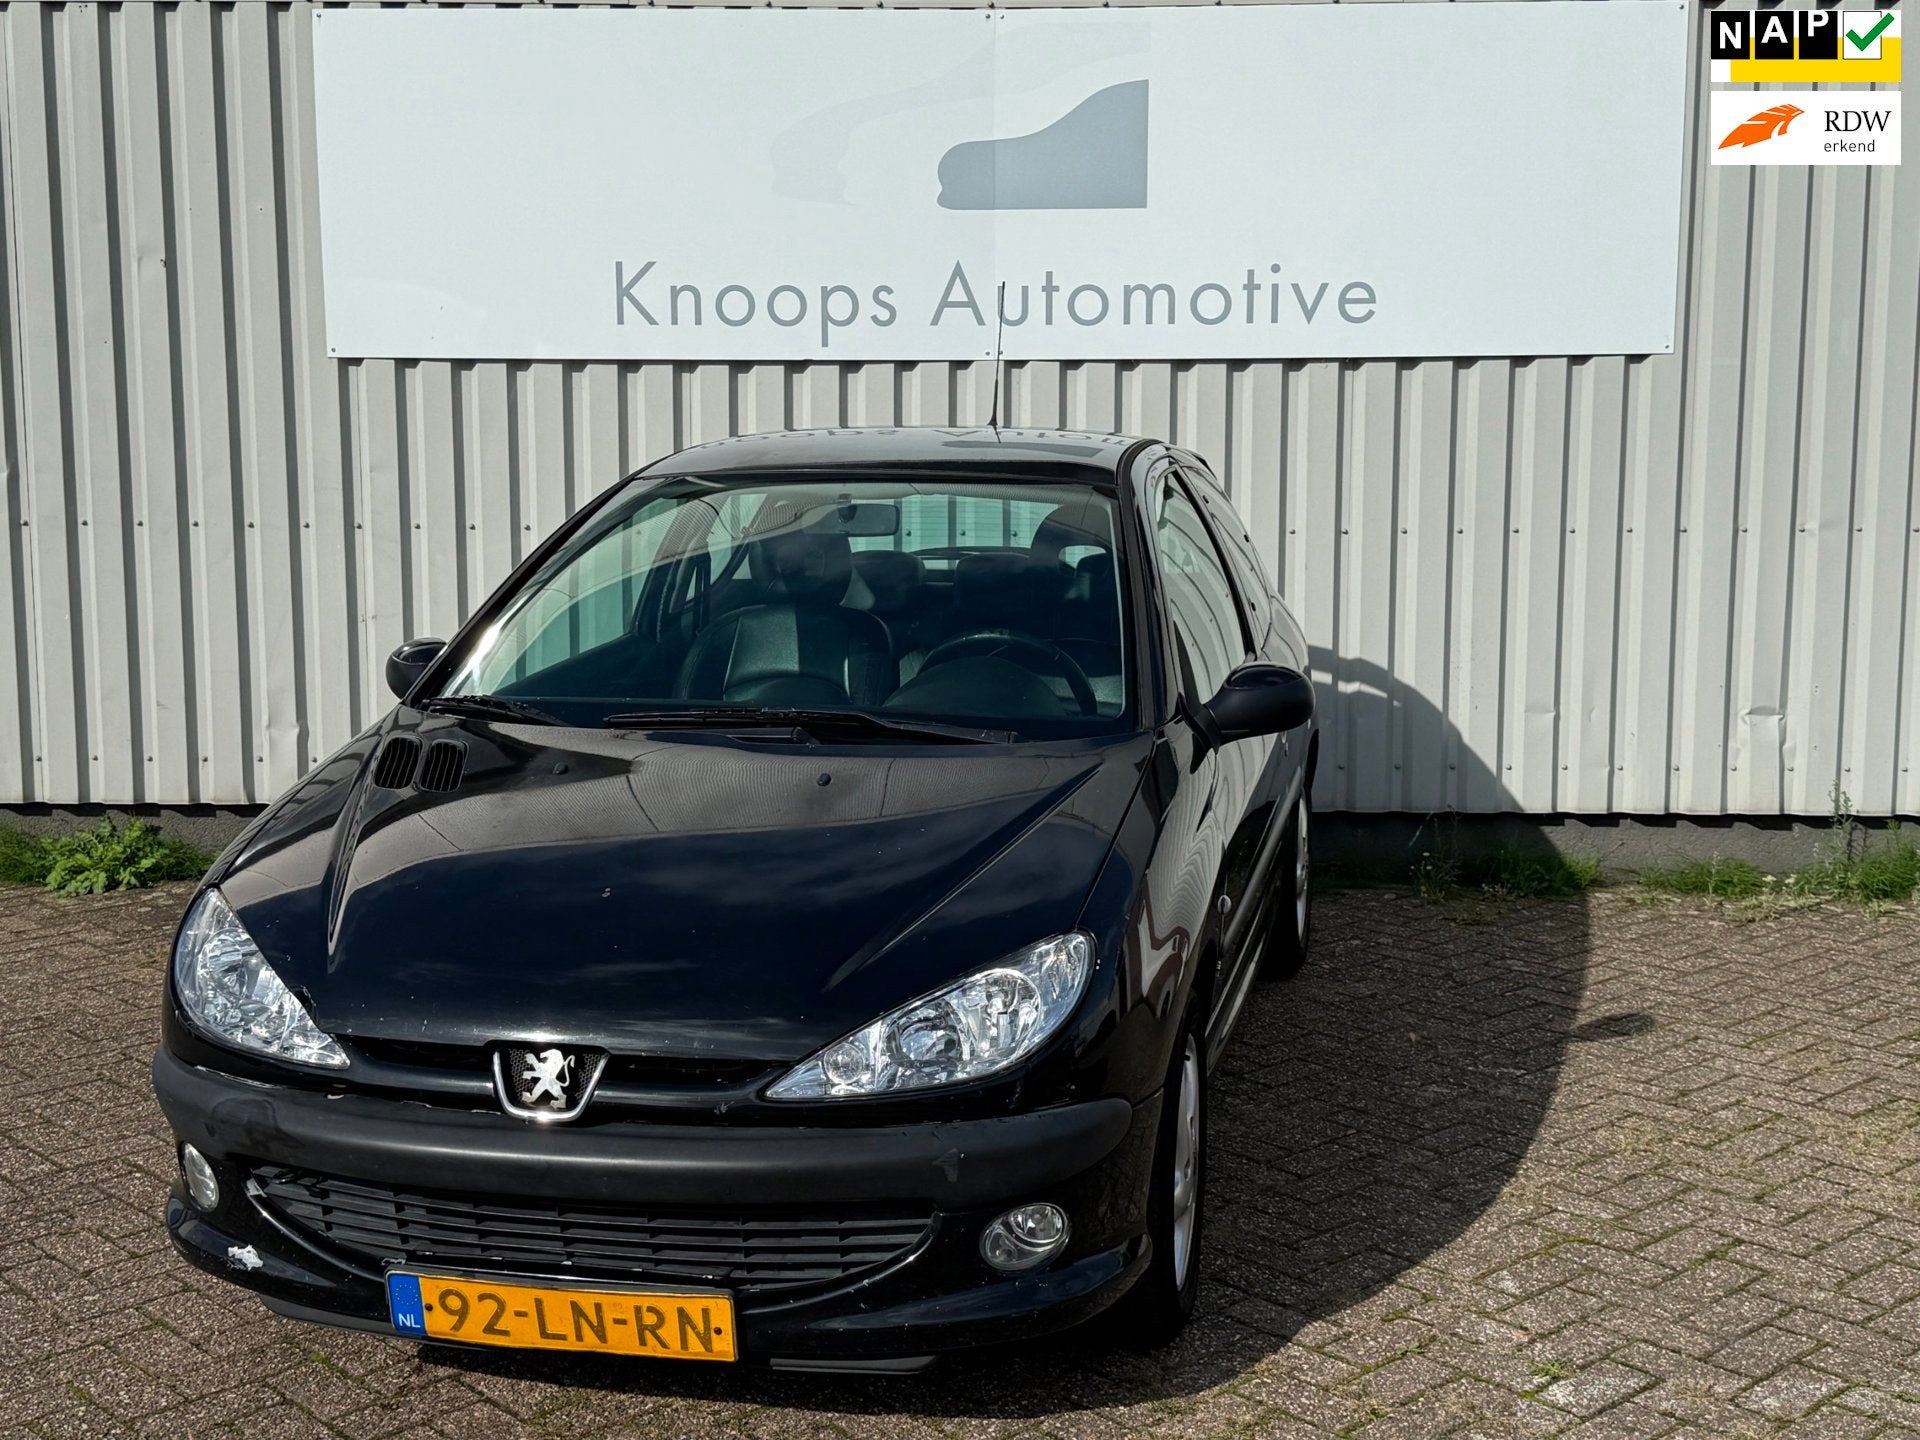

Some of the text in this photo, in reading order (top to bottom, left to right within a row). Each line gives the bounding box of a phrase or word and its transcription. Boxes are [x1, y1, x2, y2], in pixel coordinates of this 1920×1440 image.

[614, 259, 1378, 348] Knoops Automotive
[397, 1312, 421, 1329] NL
[437, 1286, 714, 1354] 92-LN-RN
